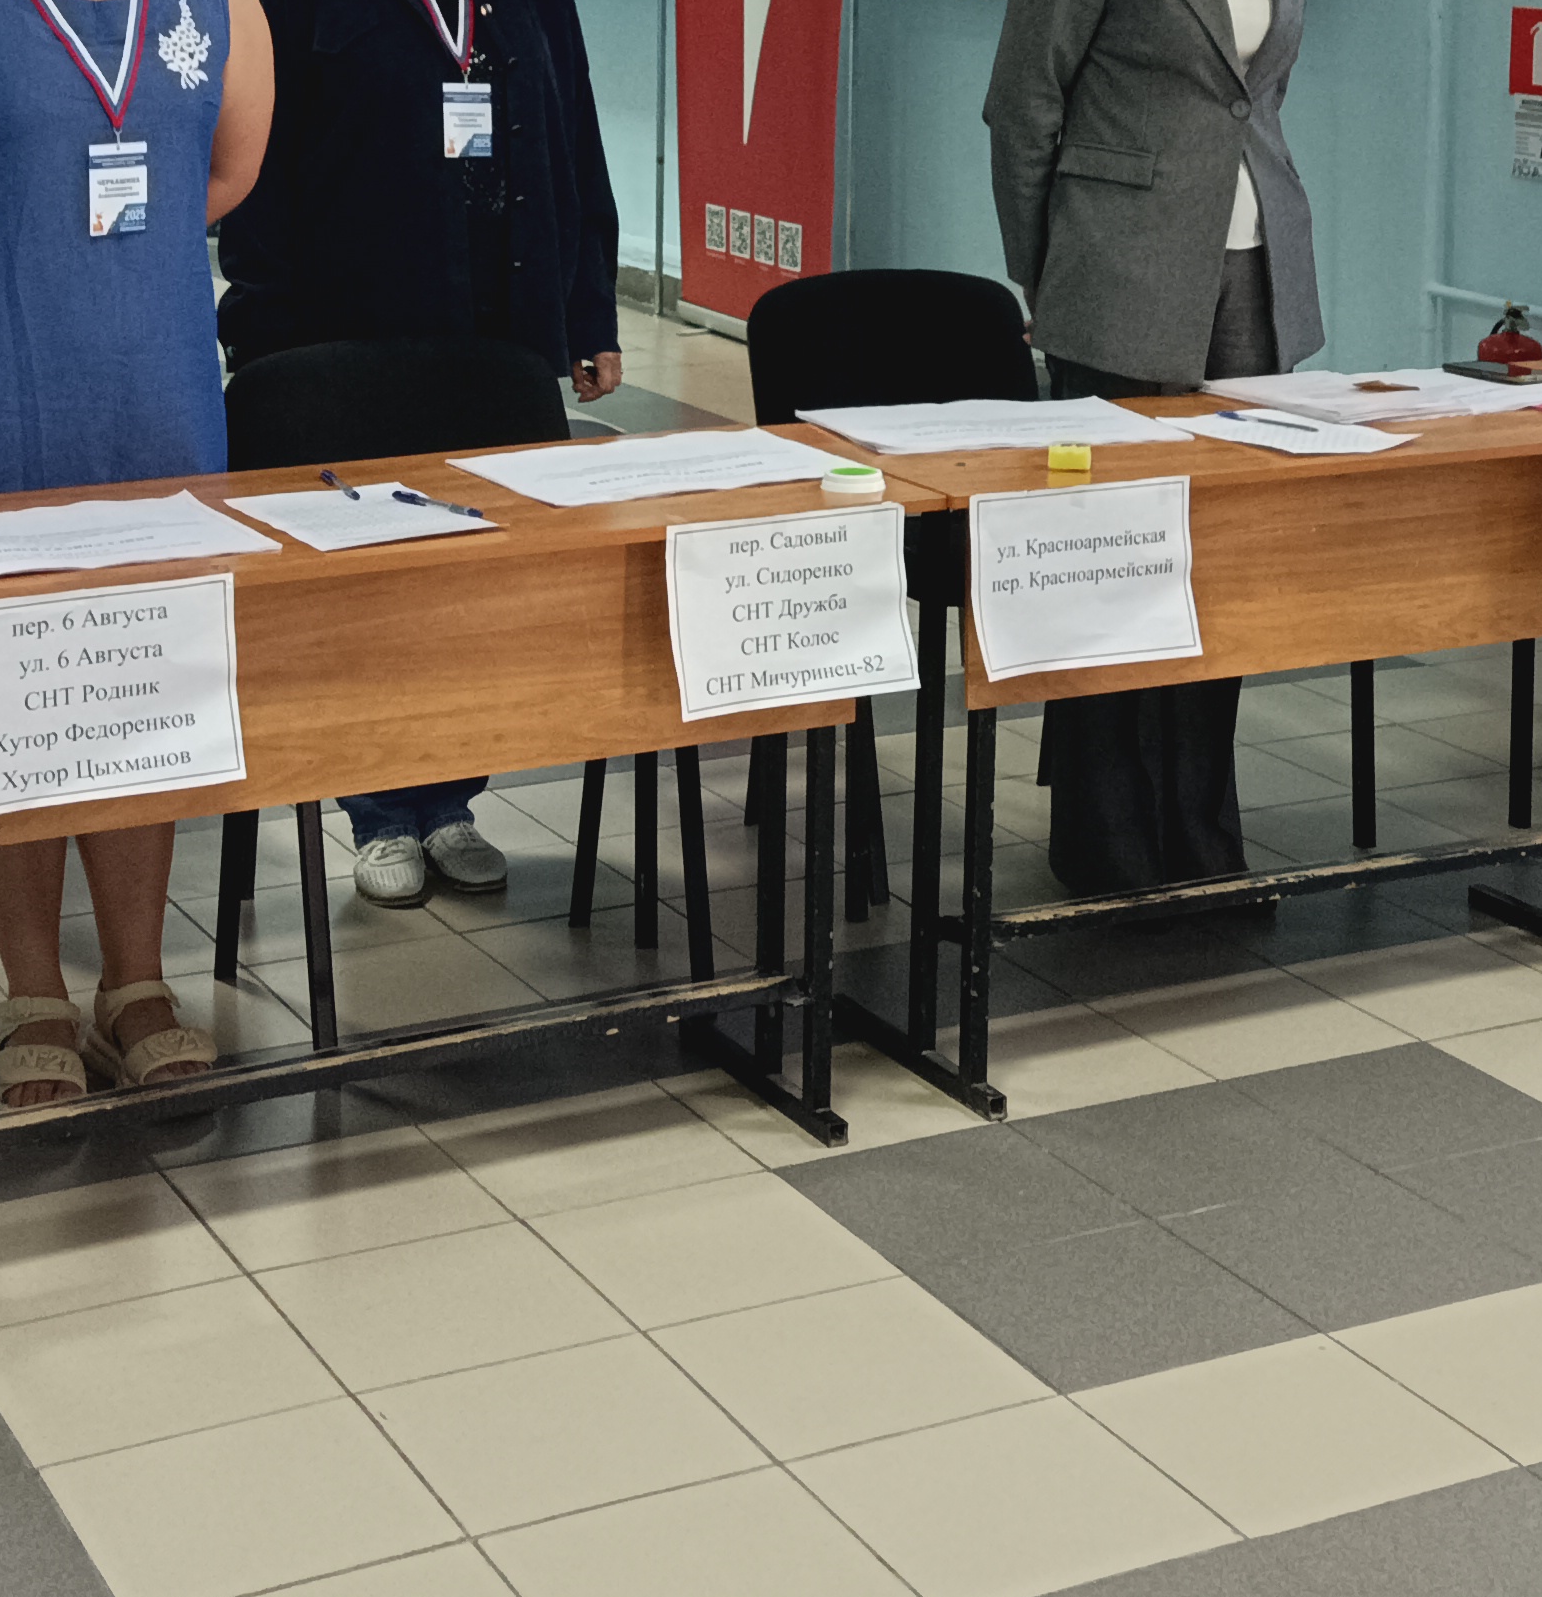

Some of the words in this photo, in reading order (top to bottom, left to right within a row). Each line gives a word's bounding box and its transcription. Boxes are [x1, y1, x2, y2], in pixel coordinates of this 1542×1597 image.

[729, 539, 764, 556] пер.
[770, 525, 847, 550] Садовый
[997, 546, 1020, 563] ул.
[1026, 530, 1166, 558] Красноармейская
[725, 575, 750, 593] ул.
[756, 562, 853, 585] Сидоренко
[992, 578, 1023, 594] пер.
[1029, 558, 1173, 589] Красноармейский
[12, 618, 54, 638] пер.
[62, 613, 74, 630] 6
[81, 606, 168, 628] Августа
[732, 601, 773, 622] СНТ
[778, 593, 847, 620] Дружба
[741, 634, 781, 655] СНТ
[788, 630, 839, 649] Колос
[19, 658, 50, 680] ул.
[57, 649, 70, 668] 6
[76, 643, 163, 667] Августа
[706, 673, 745, 695] СНТ
[751, 654, 885, 689] Мичуринец-82
[24, 686, 74, 711] СНТ
[82, 680, 160, 704] Родник
[65, 711, 196, 742] Федоренков
[2, 767, 68, 792] Хутор
[76, 749, 191, 780] Цыхманов
